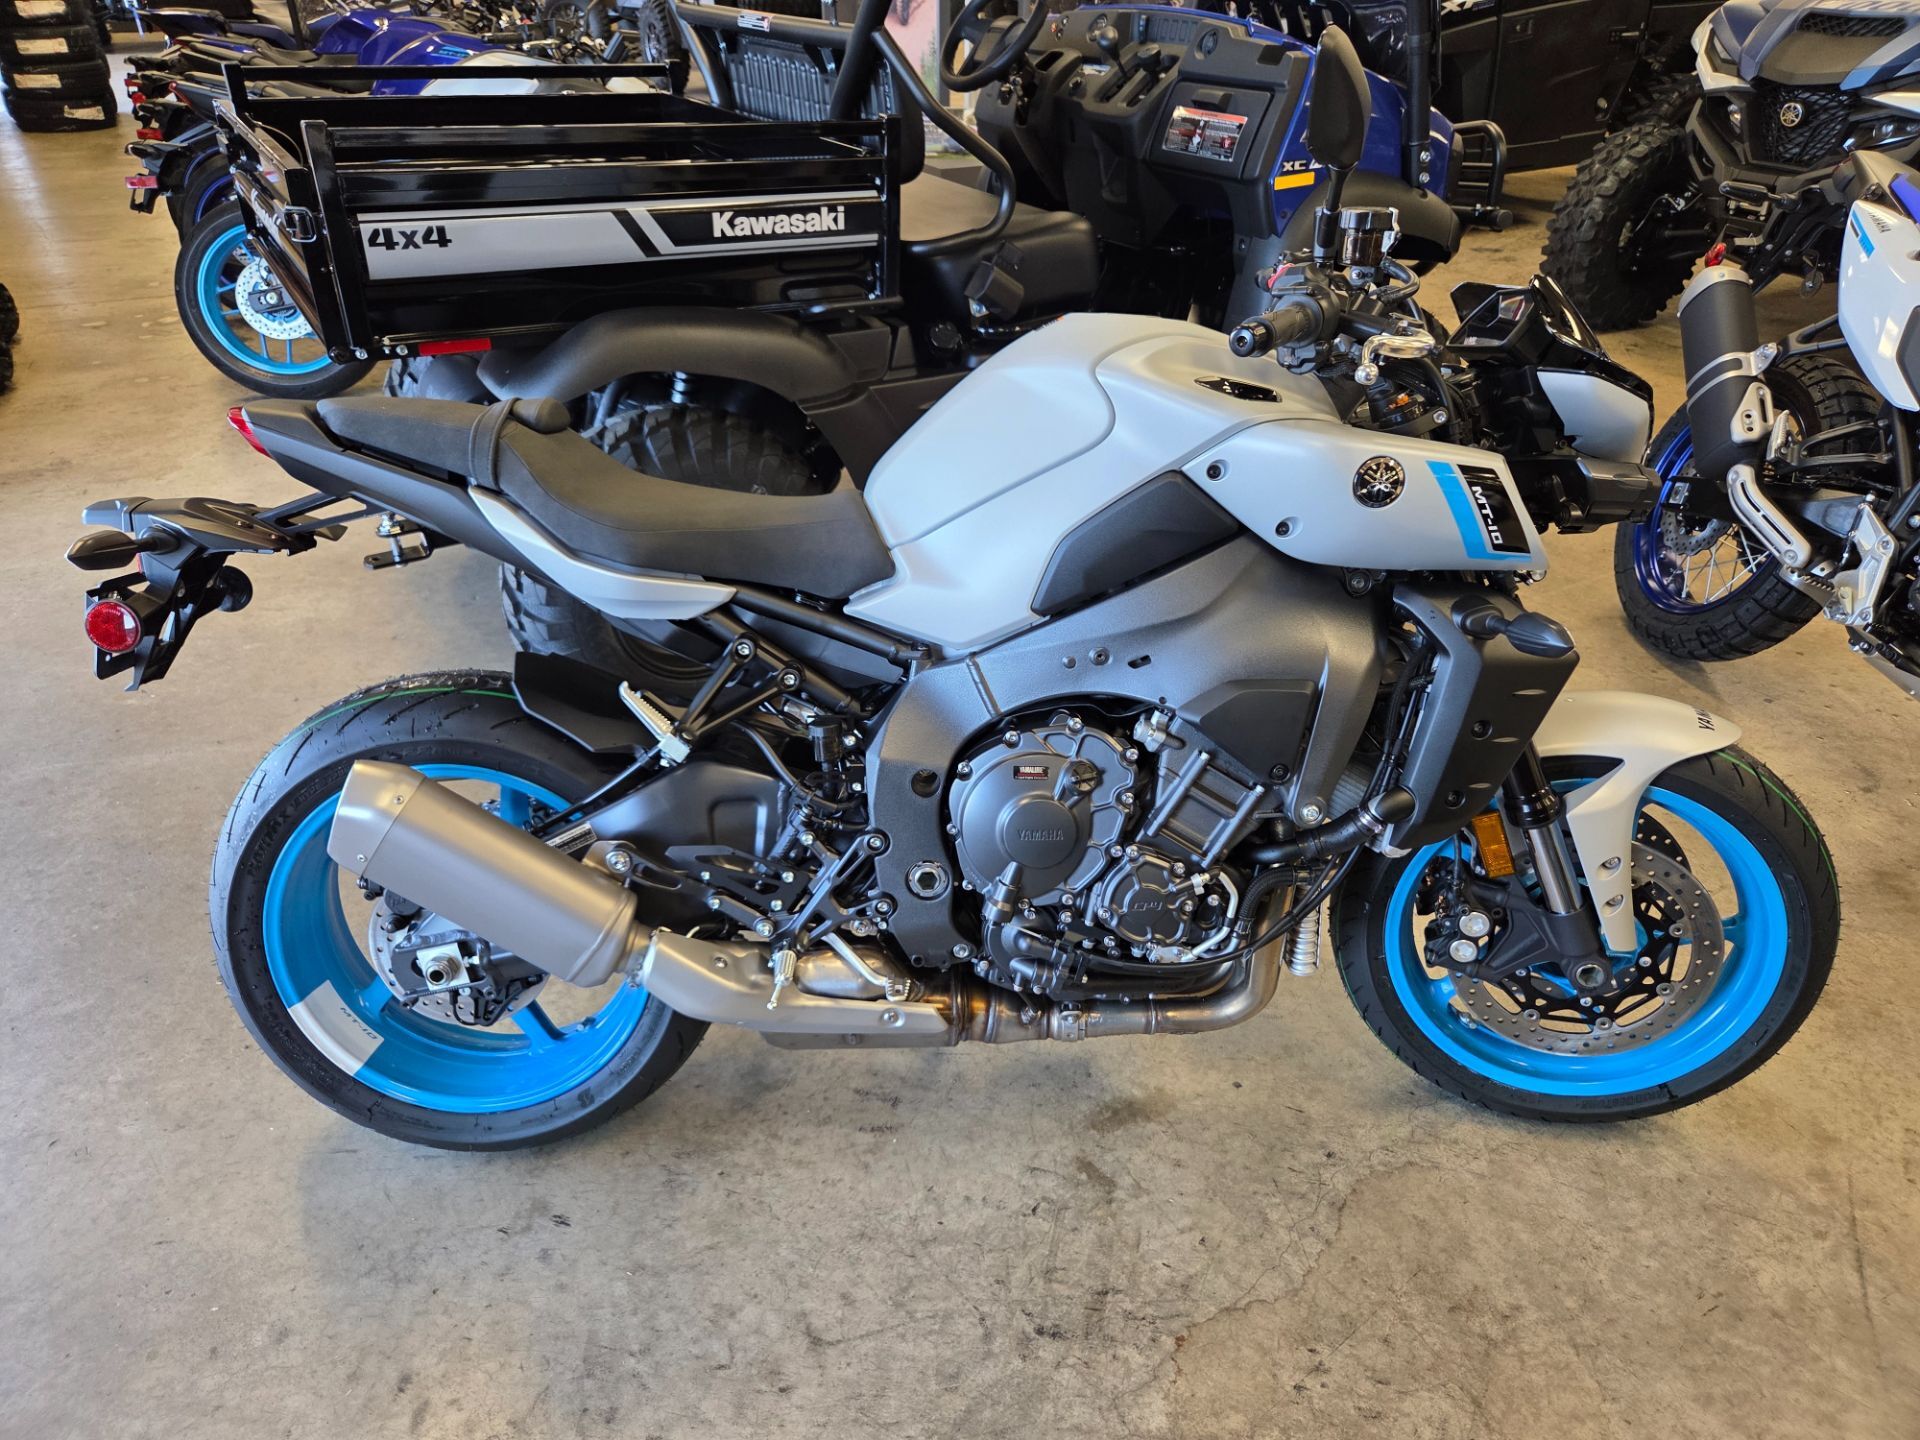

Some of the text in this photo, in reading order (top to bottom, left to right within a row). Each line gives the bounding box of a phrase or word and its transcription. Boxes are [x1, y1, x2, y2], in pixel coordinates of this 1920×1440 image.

[1282, 160, 1307, 171] XC
[712, 206, 845, 237] Kawasaki
[368, 226, 452, 251] 4x4
[1471, 486, 1503, 544] MT-10
[1017, 829, 1064, 841] YAMAHA
[340, 1007, 378, 1040] MT-10
